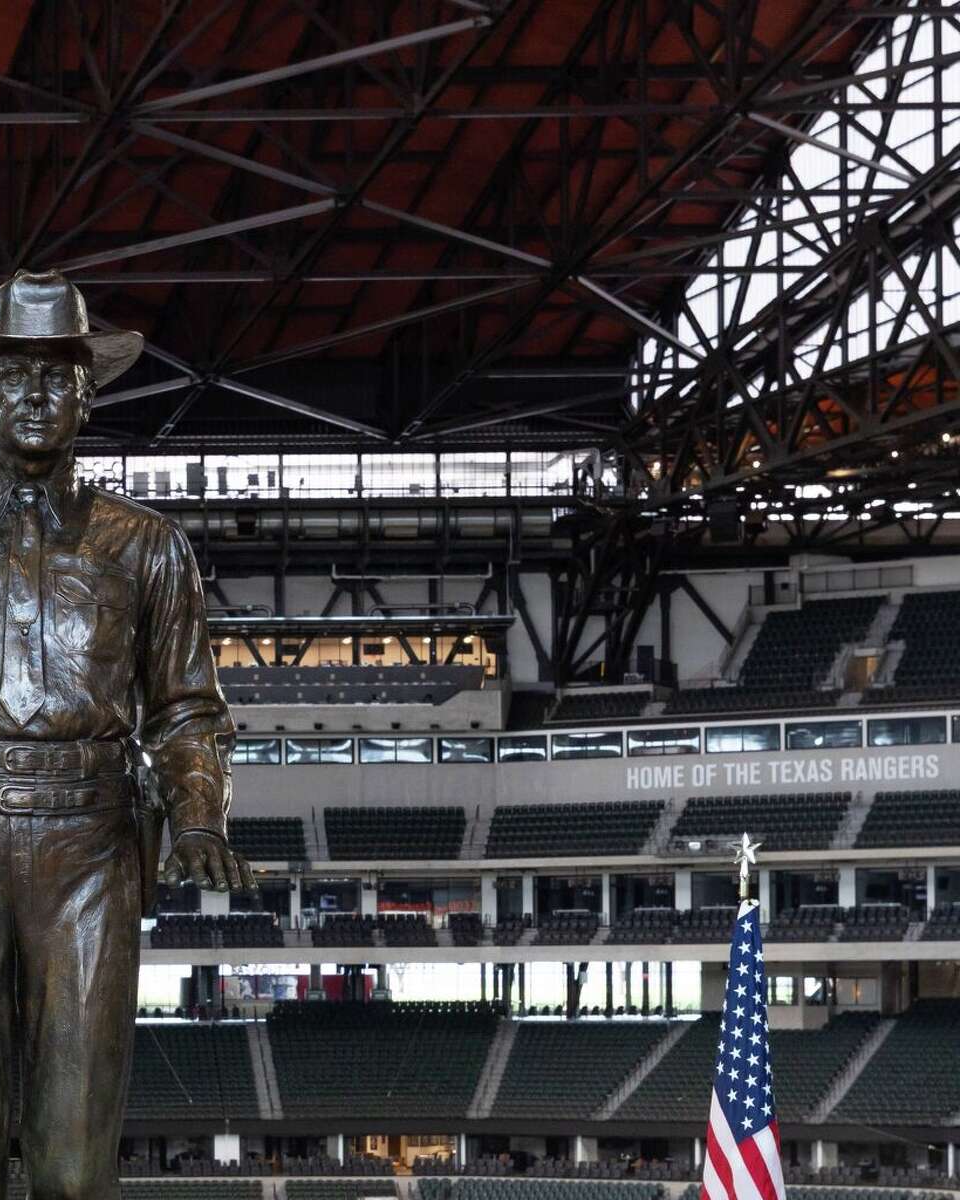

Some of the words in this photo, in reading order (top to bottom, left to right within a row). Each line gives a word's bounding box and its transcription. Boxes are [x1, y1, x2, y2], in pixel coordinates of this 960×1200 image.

[627, 765, 685, 790] HOME
[692, 763, 717, 786] OF
[723, 761, 761, 785] THE
[768, 759, 833, 784] TEXAS
[841, 754, 939, 781] RANGERS
